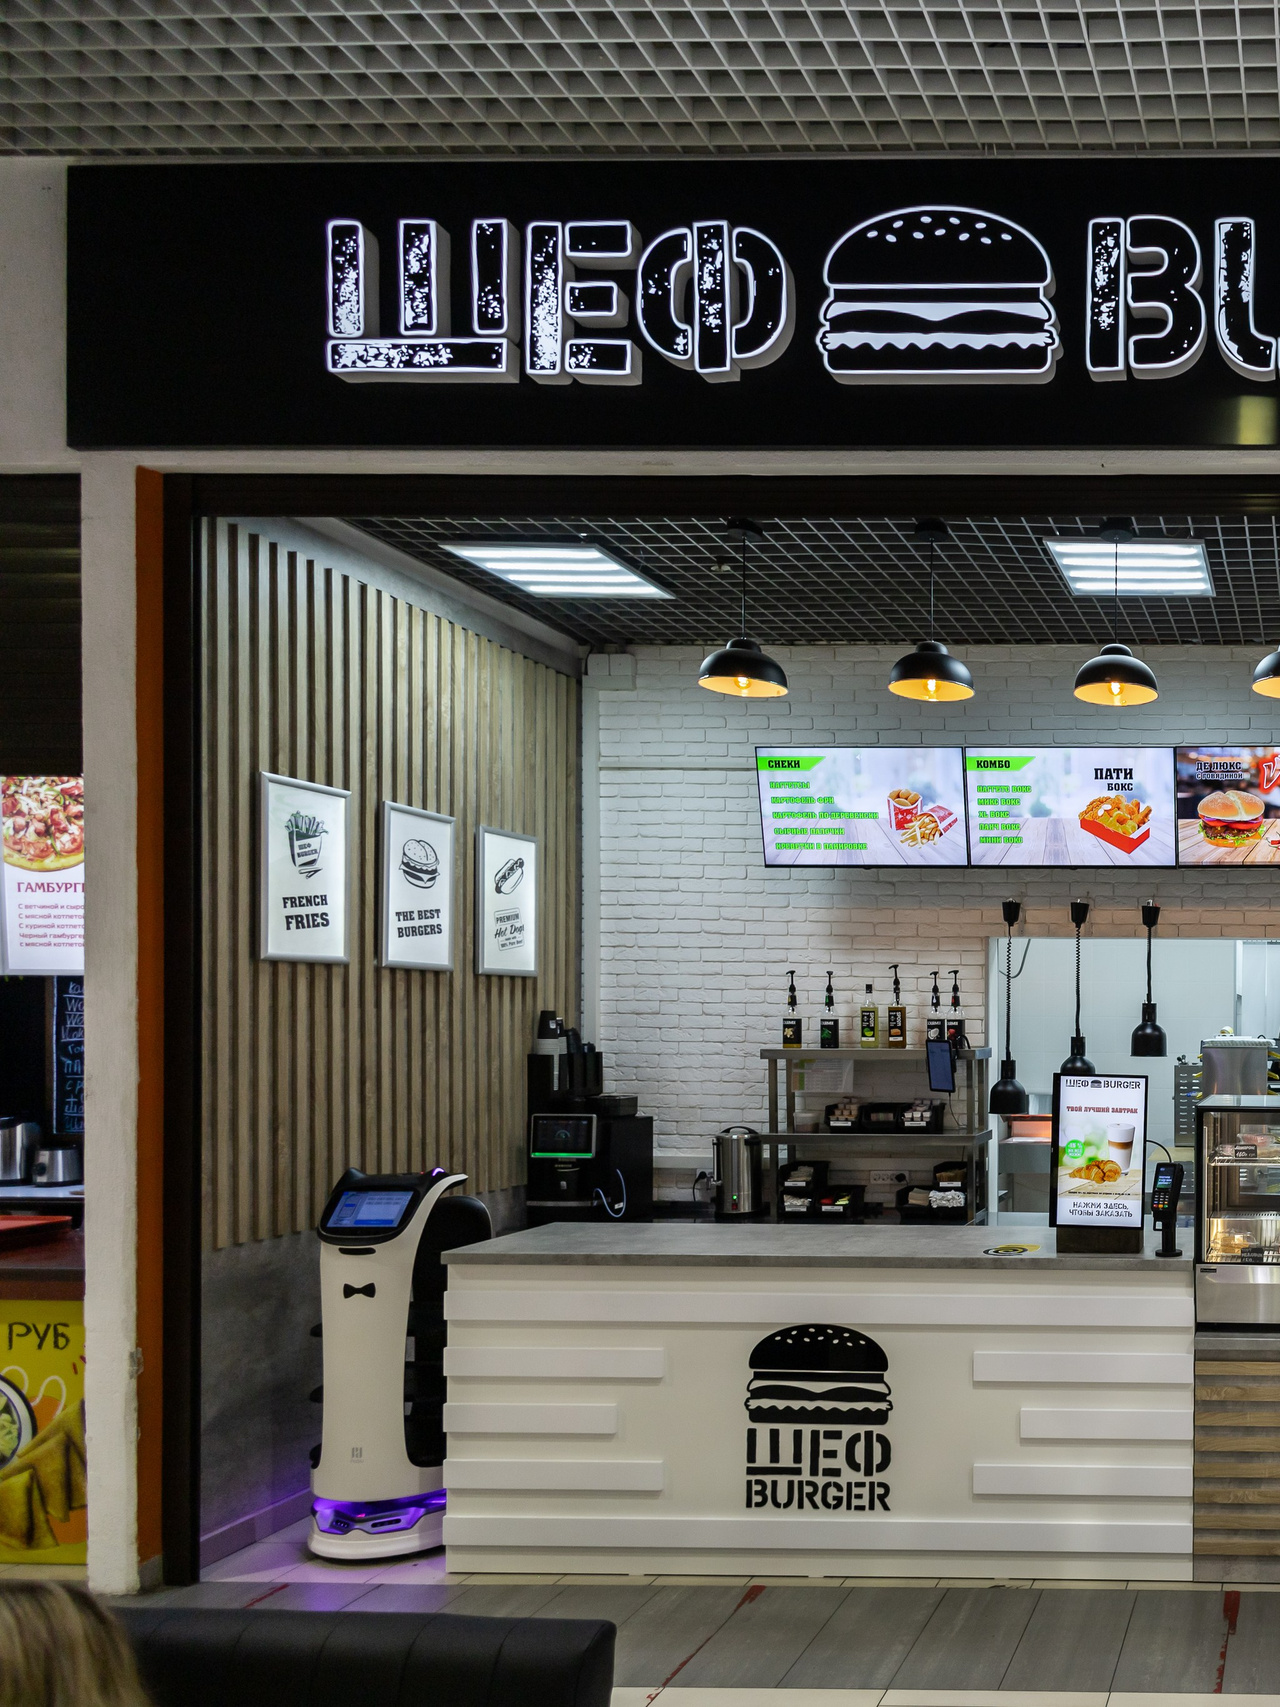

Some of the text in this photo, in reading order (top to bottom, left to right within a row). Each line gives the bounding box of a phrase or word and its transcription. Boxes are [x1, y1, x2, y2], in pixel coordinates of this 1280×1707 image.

[326, 218, 797, 384] ШЕФ
[767, 759, 801, 769] СНЕКИ
[976, 759, 1011, 769] КОМБО
[1196, 761, 1242, 771] ДЕ ЛЮКС
[1094, 768, 1134, 780] ПАТИ
[1107, 783, 1134, 791] БОКС
[771, 796, 816, 804] КАРТОФЕЛЬ
[282, 894, 328, 909] FRENCH
[395, 908, 442, 922] THE BEST
[496, 913, 520, 924] PREMIUM
[285, 912, 330, 930] FRIES
[49, 932, 84, 940] гамбурге
[397, 923, 443, 938] BURGERS
[1065, 1079, 1089, 1087] ШЕФ
[1103, 1080, 1141, 1089] BURGER
[8, 1321, 70, 1350] РУБ
[746, 1428, 892, 1477] ШЕФ
[746, 1479, 891, 1511] BURGER
